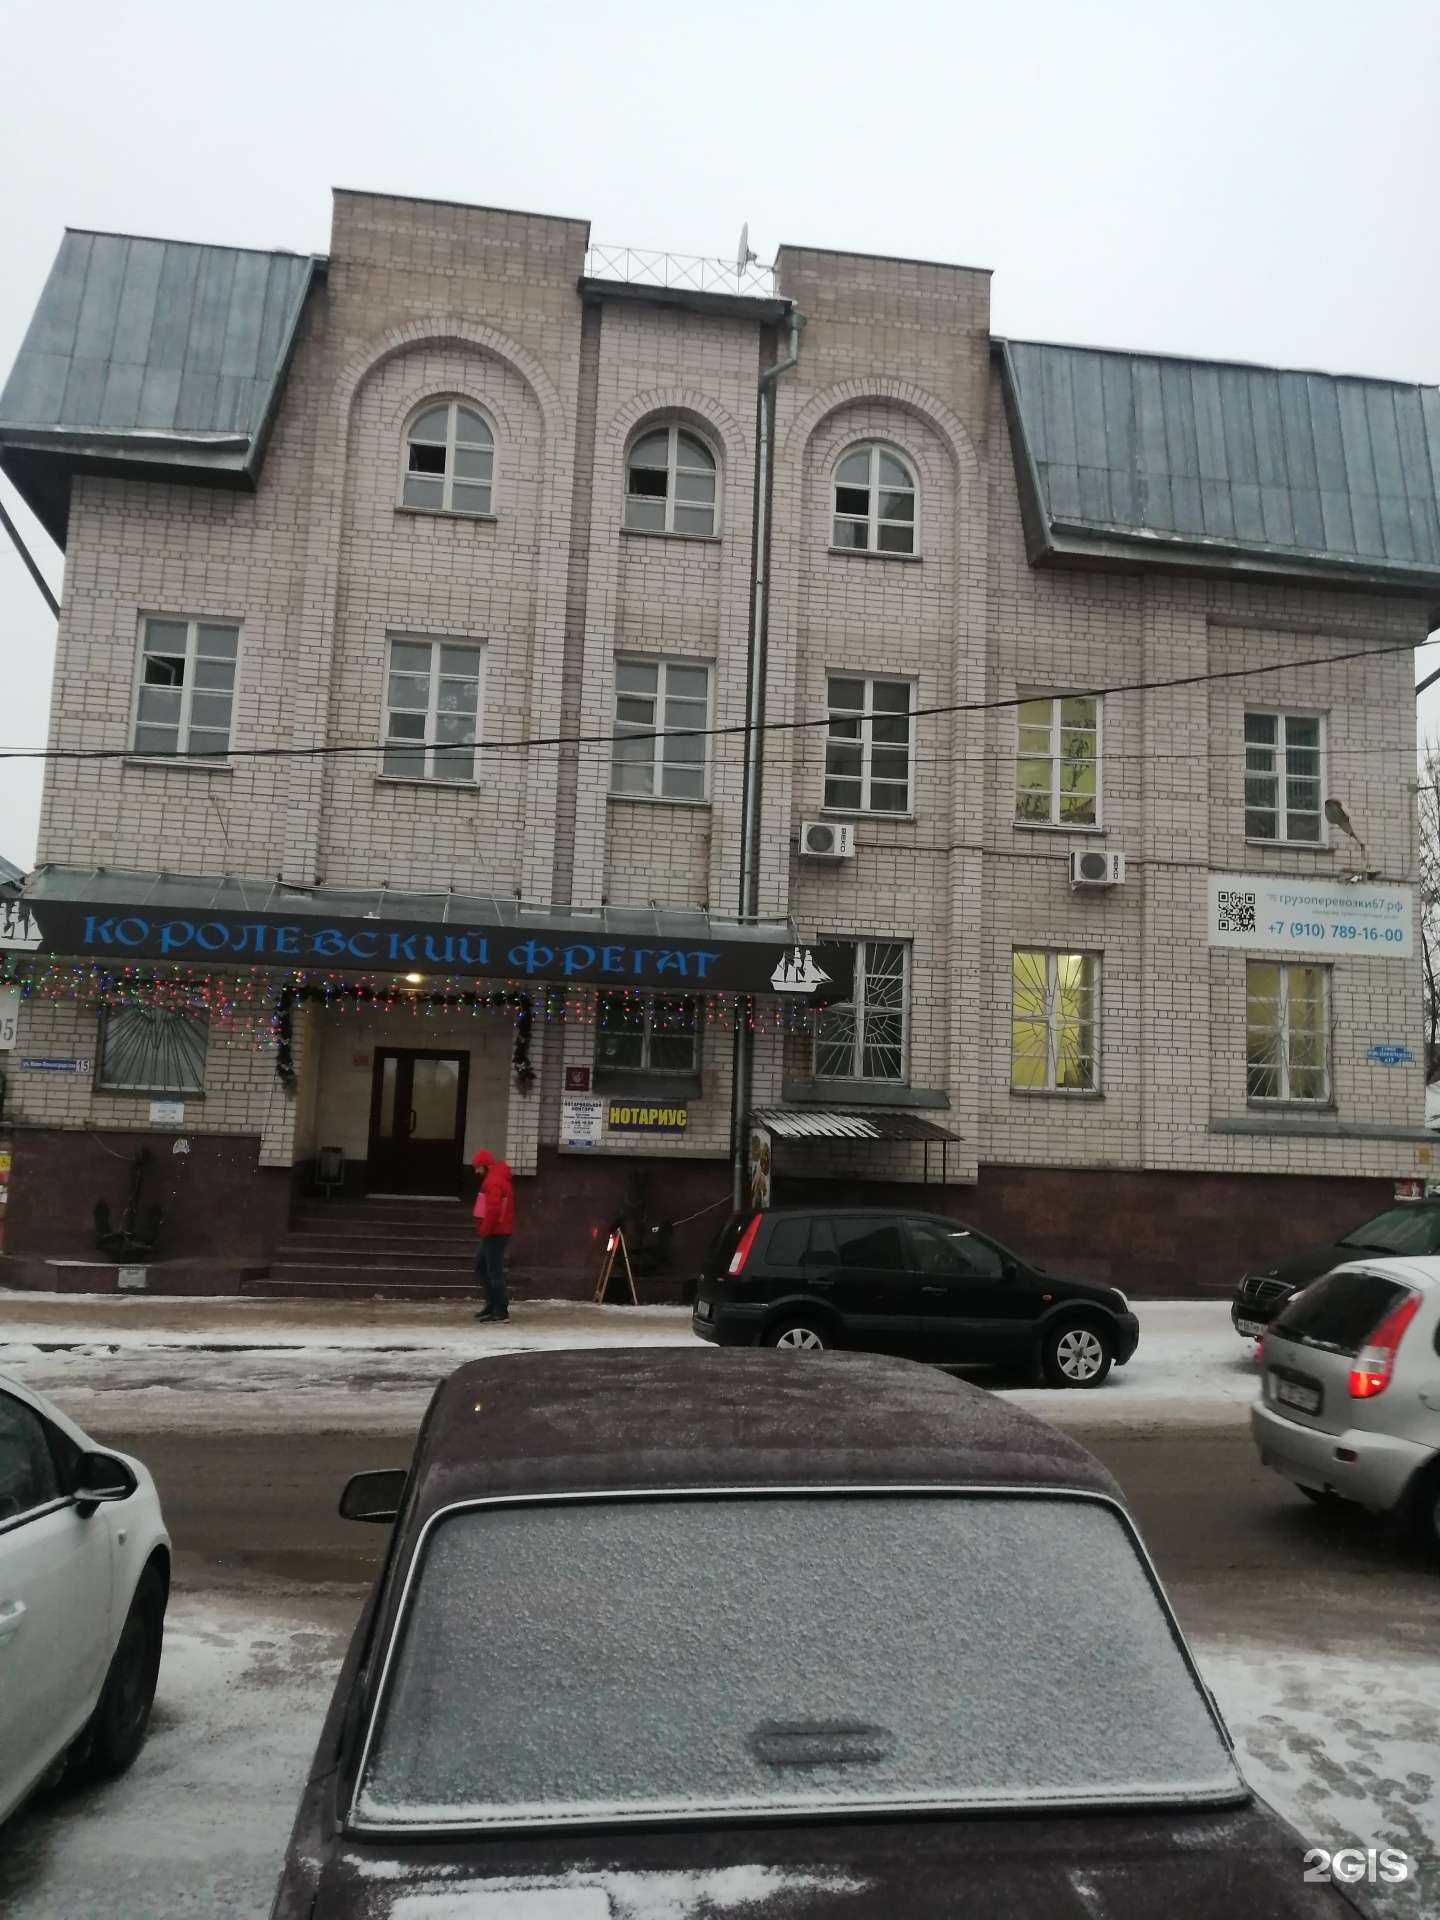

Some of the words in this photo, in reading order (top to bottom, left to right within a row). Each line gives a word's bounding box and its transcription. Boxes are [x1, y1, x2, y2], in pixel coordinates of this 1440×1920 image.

[1267, 921, 1284, 935] +7
[1290, 922, 1326, 939] (910)
[1330, 925, 1404, 942] 789-16-00
[84, 912, 489, 966] КОРОЛЕВСКИЙ
[507, 938, 722, 978] ФРЕГАТ
[0, 1018, 14, 1041] 5
[77, 1060, 90, 1073] 15
[609, 1107, 688, 1127] НОТАРИУС
